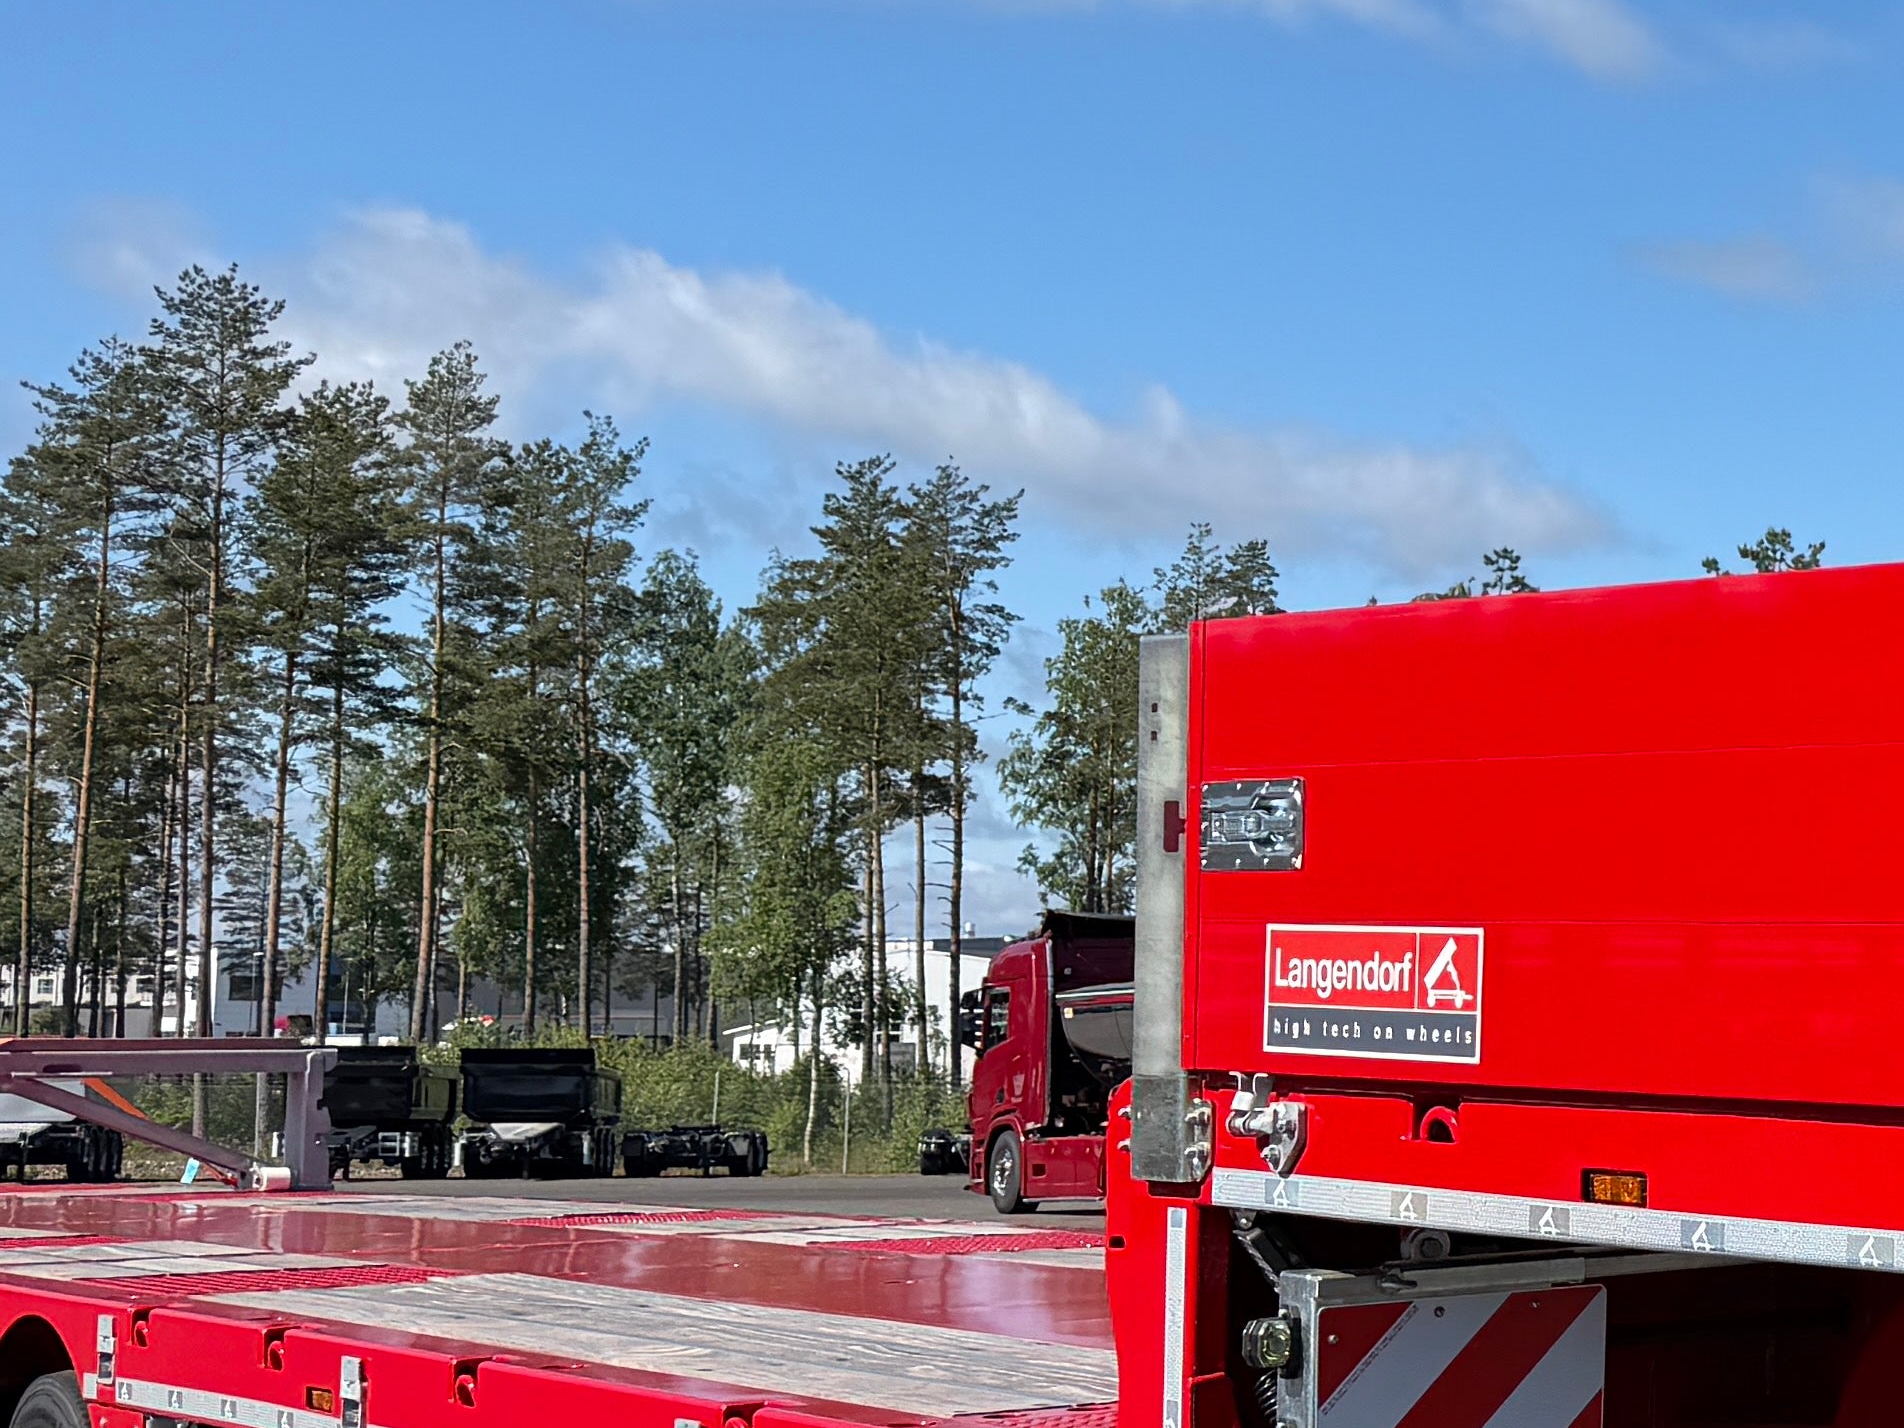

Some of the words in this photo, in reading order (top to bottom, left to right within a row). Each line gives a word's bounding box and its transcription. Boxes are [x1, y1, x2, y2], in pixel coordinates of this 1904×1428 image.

[1275, 947, 1413, 999] Langendorf
[1273, 1017, 1311, 1039] high
[1322, 1021, 1361, 1039] tech
[1373, 1025, 1393, 1040] on
[1406, 1024, 1472, 1045] wheels
